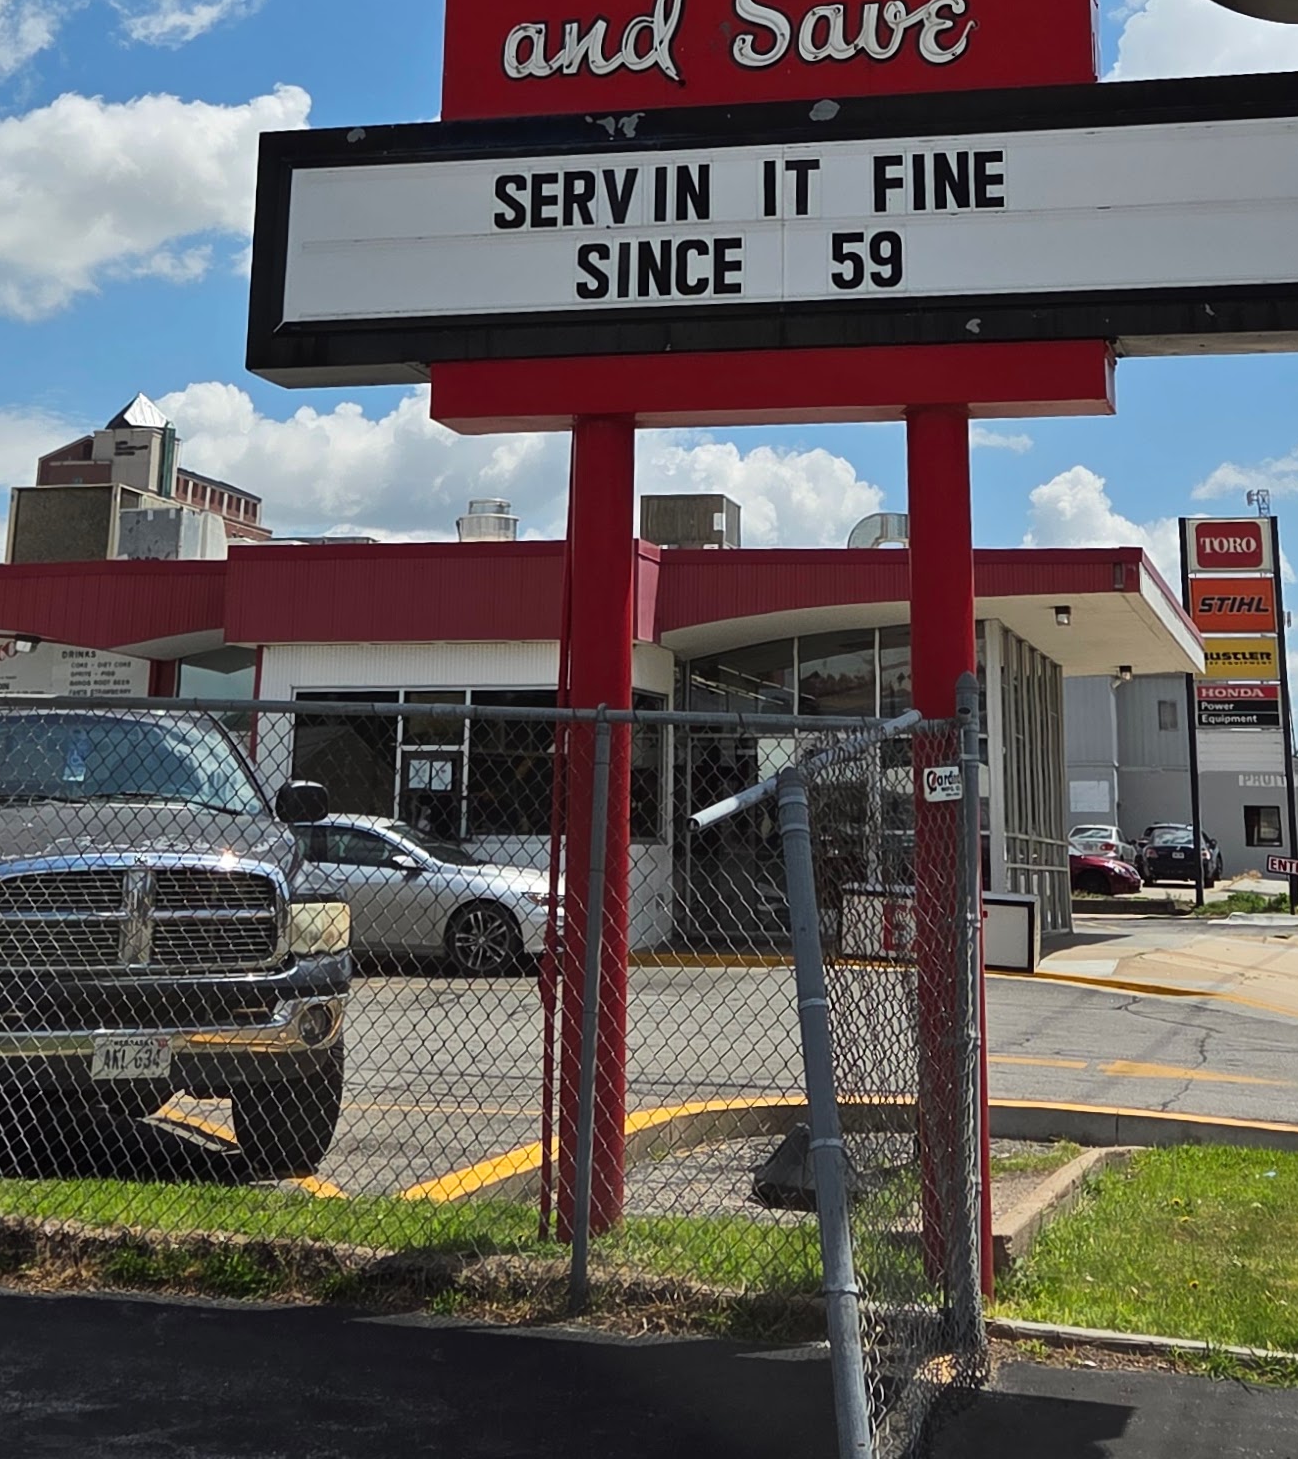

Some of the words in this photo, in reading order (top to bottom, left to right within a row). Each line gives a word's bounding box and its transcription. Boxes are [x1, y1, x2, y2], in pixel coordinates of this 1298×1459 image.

[763, 158, 821, 218] IT
[873, 150, 1005, 213] FINE
[576, 236, 743, 300] SINCE
[831, 230, 904, 289] 59
[1200, 536, 1257, 554] TORO
[1198, 596, 1269, 614] STIHL
[62, 650, 96, 659] DRINKS
[1201, 688, 1265, 698] HONDA
[1201, 701, 1234, 710] Power
[1201, 714, 1258, 724] Equipment
